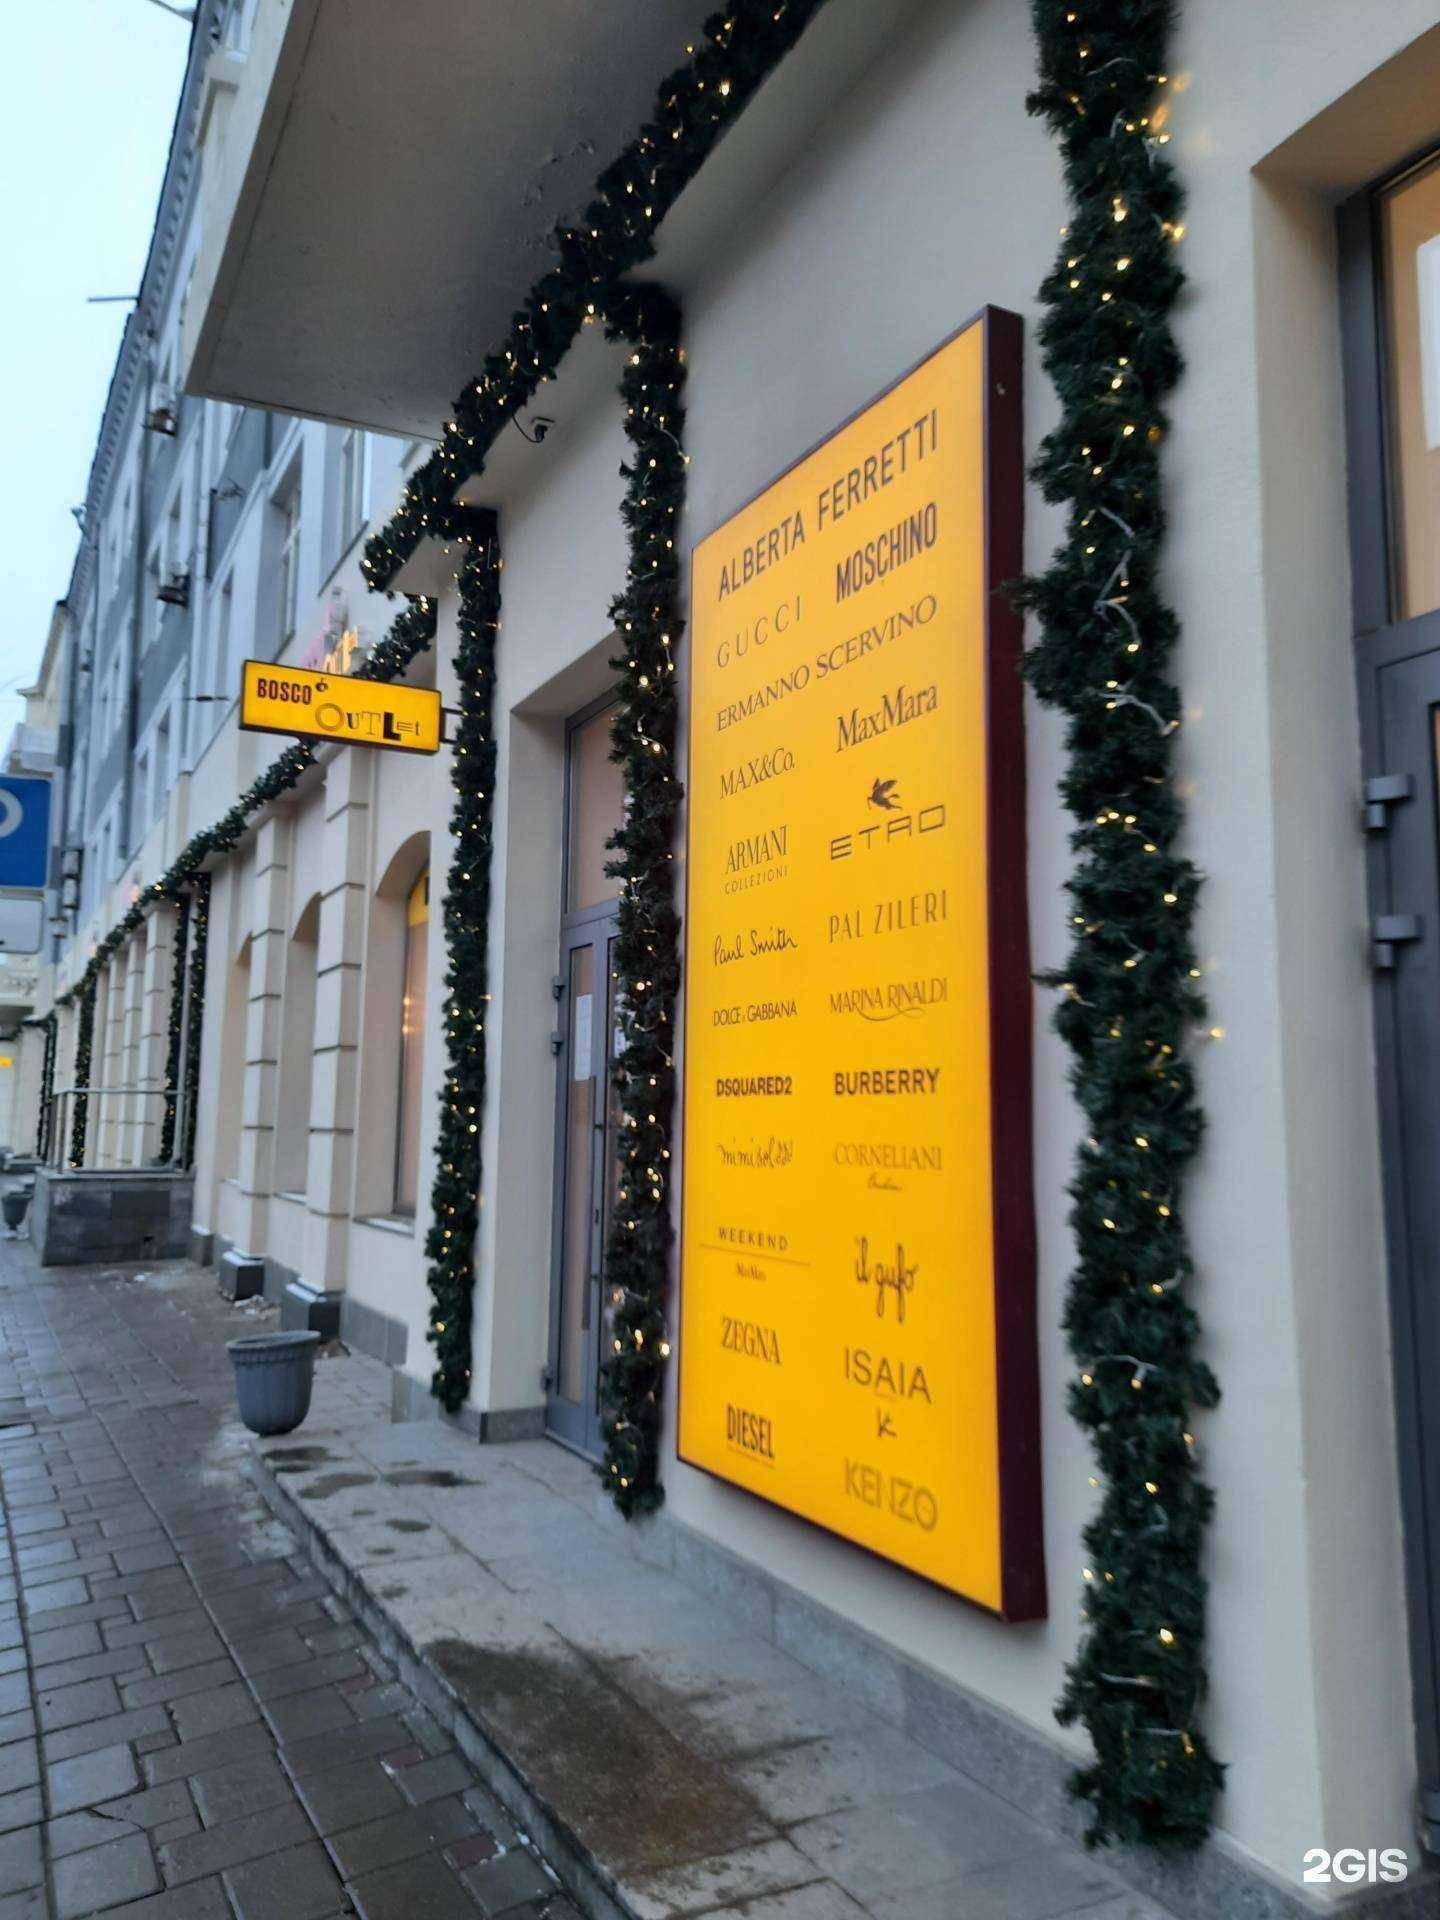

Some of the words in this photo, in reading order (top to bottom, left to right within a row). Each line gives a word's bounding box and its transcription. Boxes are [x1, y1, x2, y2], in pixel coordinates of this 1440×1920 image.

[718, 512, 805, 601] ALBERTA
[817, 409, 938, 532] FERRETTI
[836, 502, 937, 603] MOSCHINO
[717, 596, 801, 669] GUCCI
[717, 664, 810, 731] ERMANNO
[815, 595, 938, 680] SCERVINO
[257, 677, 312, 706] BOSCO
[835, 683, 939, 753] MaxMara
[724, 824, 788, 876] ARMANI
[724, 865, 788, 895] COLLEZIONI
[829, 907, 864, 944] PAL
[873, 889, 948, 935] ZILERI
[713, 934, 745, 967] Paul
[750, 926, 798, 956] Smith
[829, 986, 884, 1021] MARINA
[887, 977, 948, 1018] RINALDI
[716, 1075, 793, 1097] DSQUARED2
[834, 1067, 940, 1096] BURBERRY
[834, 1142, 942, 1171] CORNELIANI
[718, 1226, 789, 1251] WEEKEND
[721, 1316, 782, 1366] ZEGNA
[845, 1348, 932, 1404] ISAIA
[727, 1403, 776, 1460] DIESEL
[845, 1456, 938, 1532] KENZO
